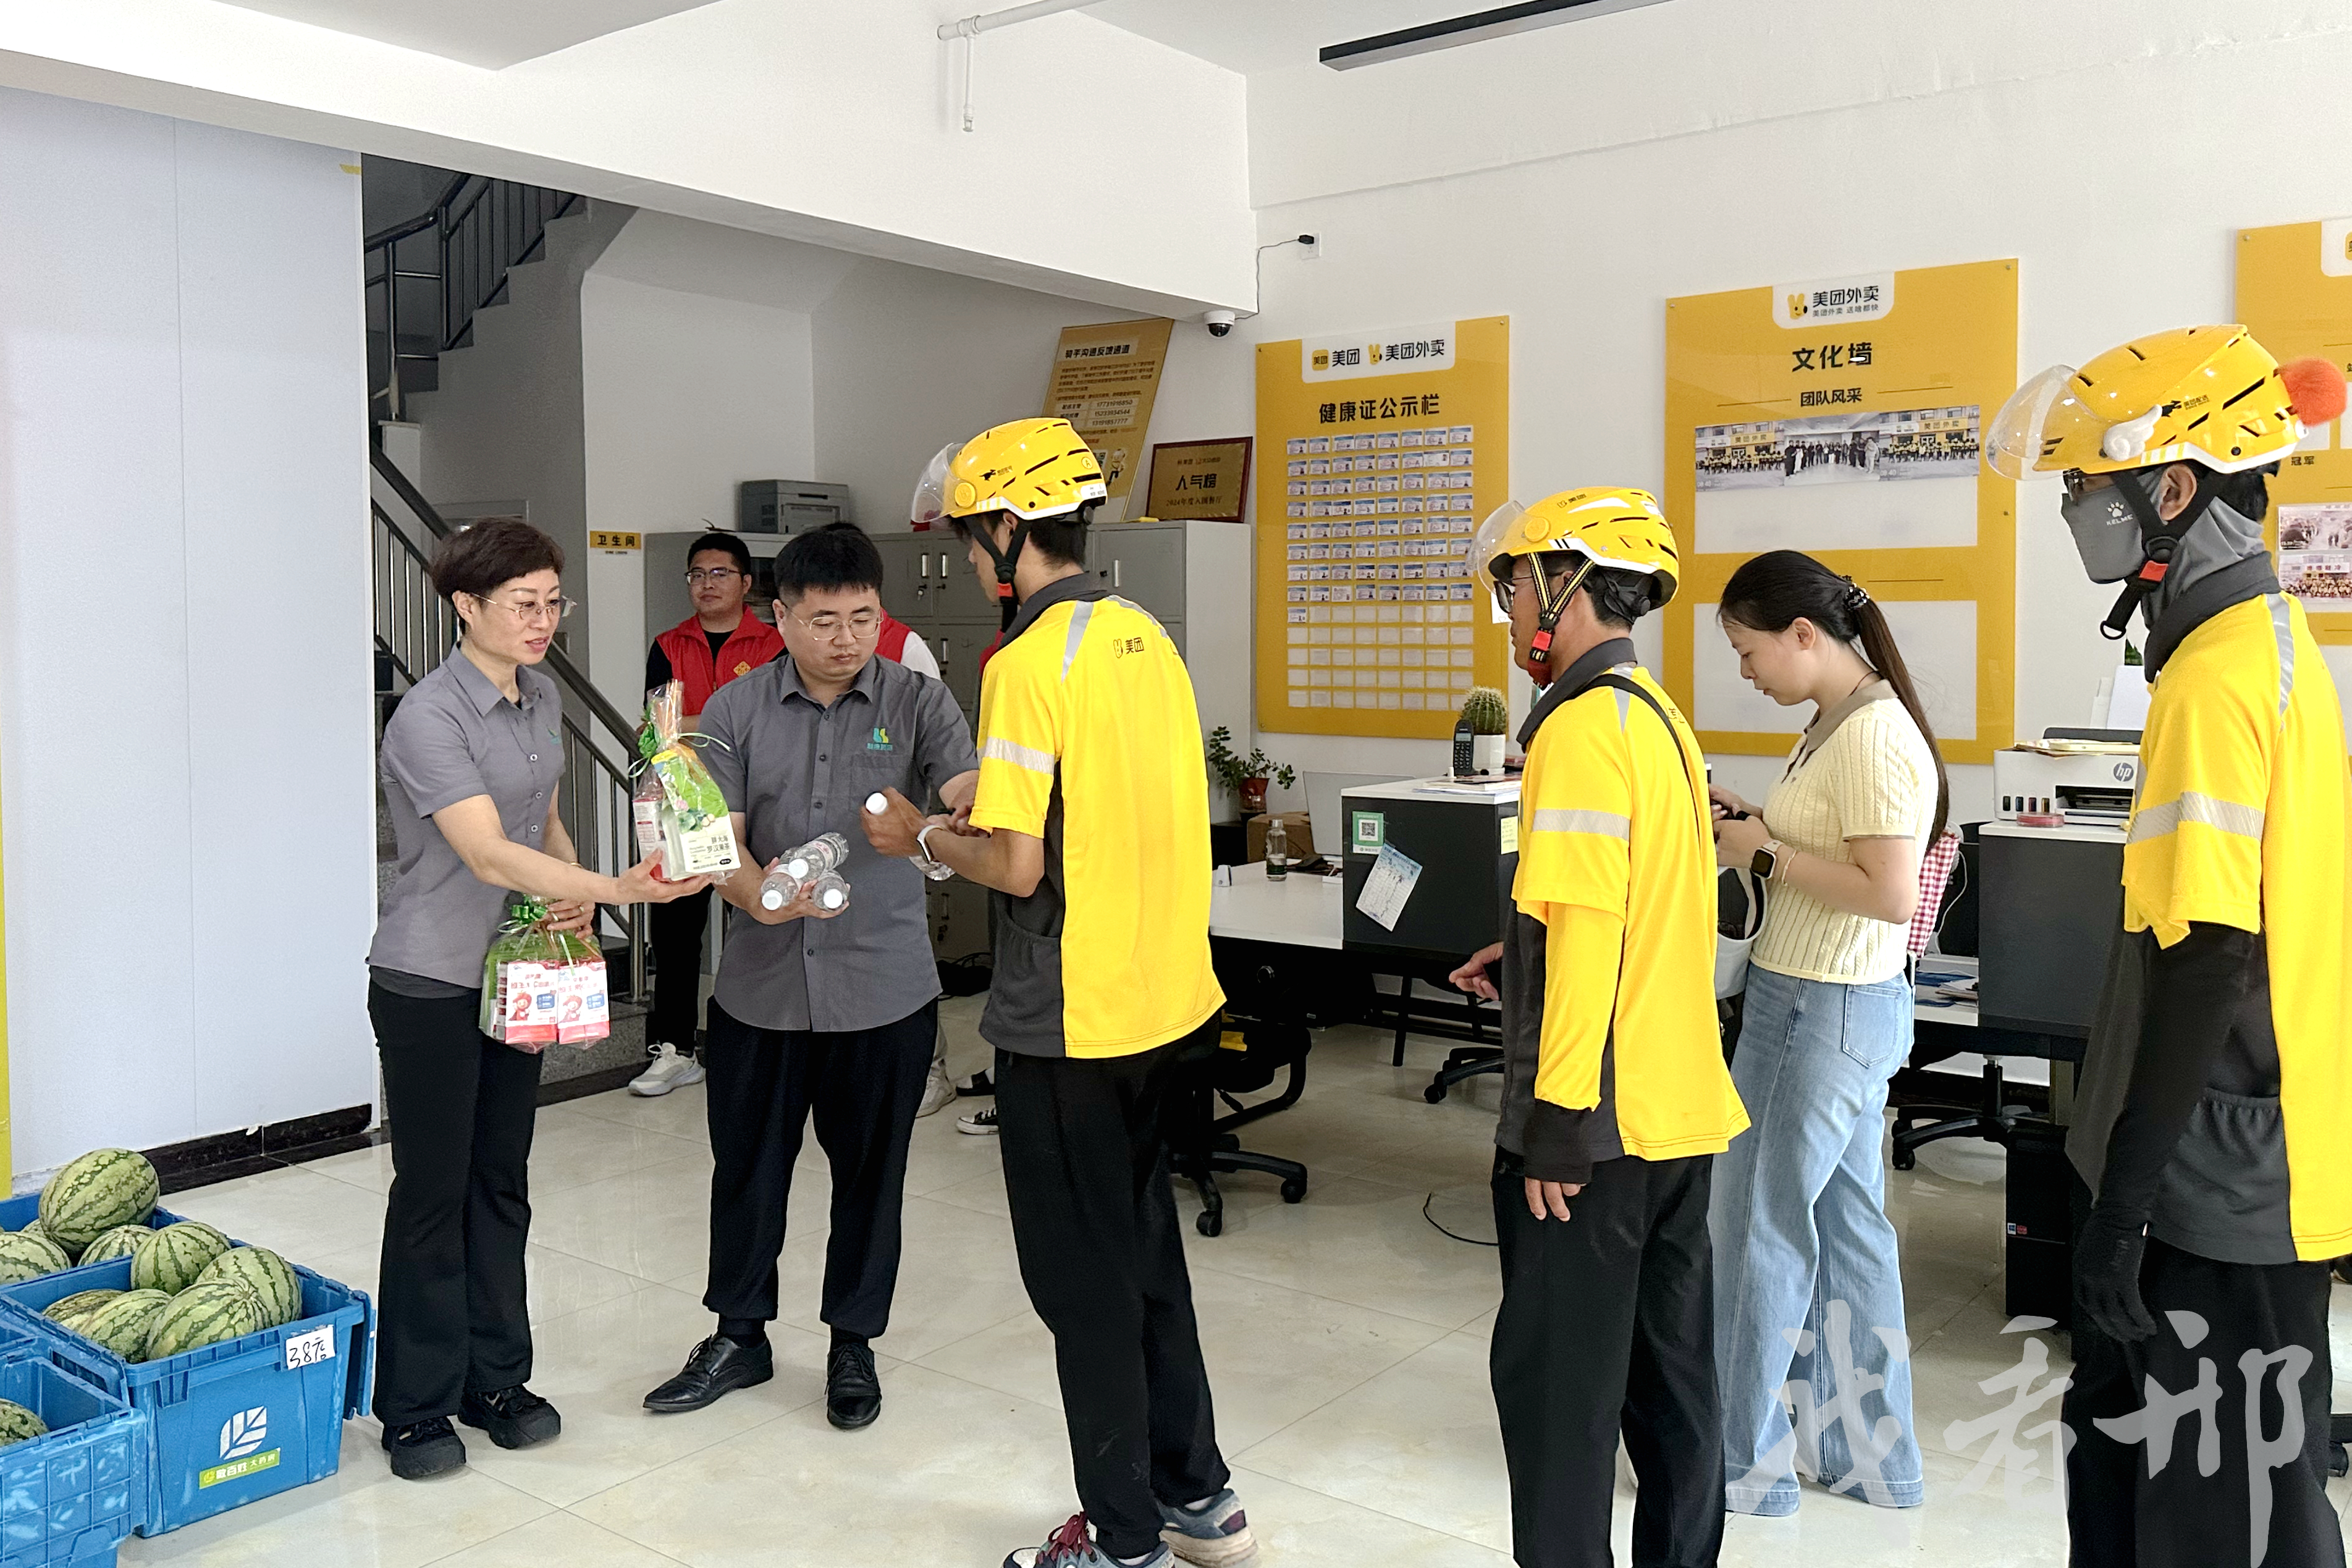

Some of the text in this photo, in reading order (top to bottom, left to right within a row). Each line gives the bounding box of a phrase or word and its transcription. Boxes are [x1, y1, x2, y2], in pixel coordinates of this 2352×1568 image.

[1813, 285, 1879, 308] 美团外卖
[1332, 348, 1360, 367] 美团
[1385, 339, 1445, 361] 美团外卖
[1792, 342, 1873, 372] 文化墙
[1800, 387, 1863, 407] 团队风采
[1318, 393, 1440, 424] 健康证公示栏
[2291, 456, 2314, 465] 冠军
[1175, 473, 1217, 491] 人气榜
[2106, 513, 2133, 525] KELME
[597, 534, 635, 547] 卫生间
[1125, 637, 1144, 654] 美团
[2115, 763, 2133, 782] hp
[711, 835, 728, 844] 胖大海
